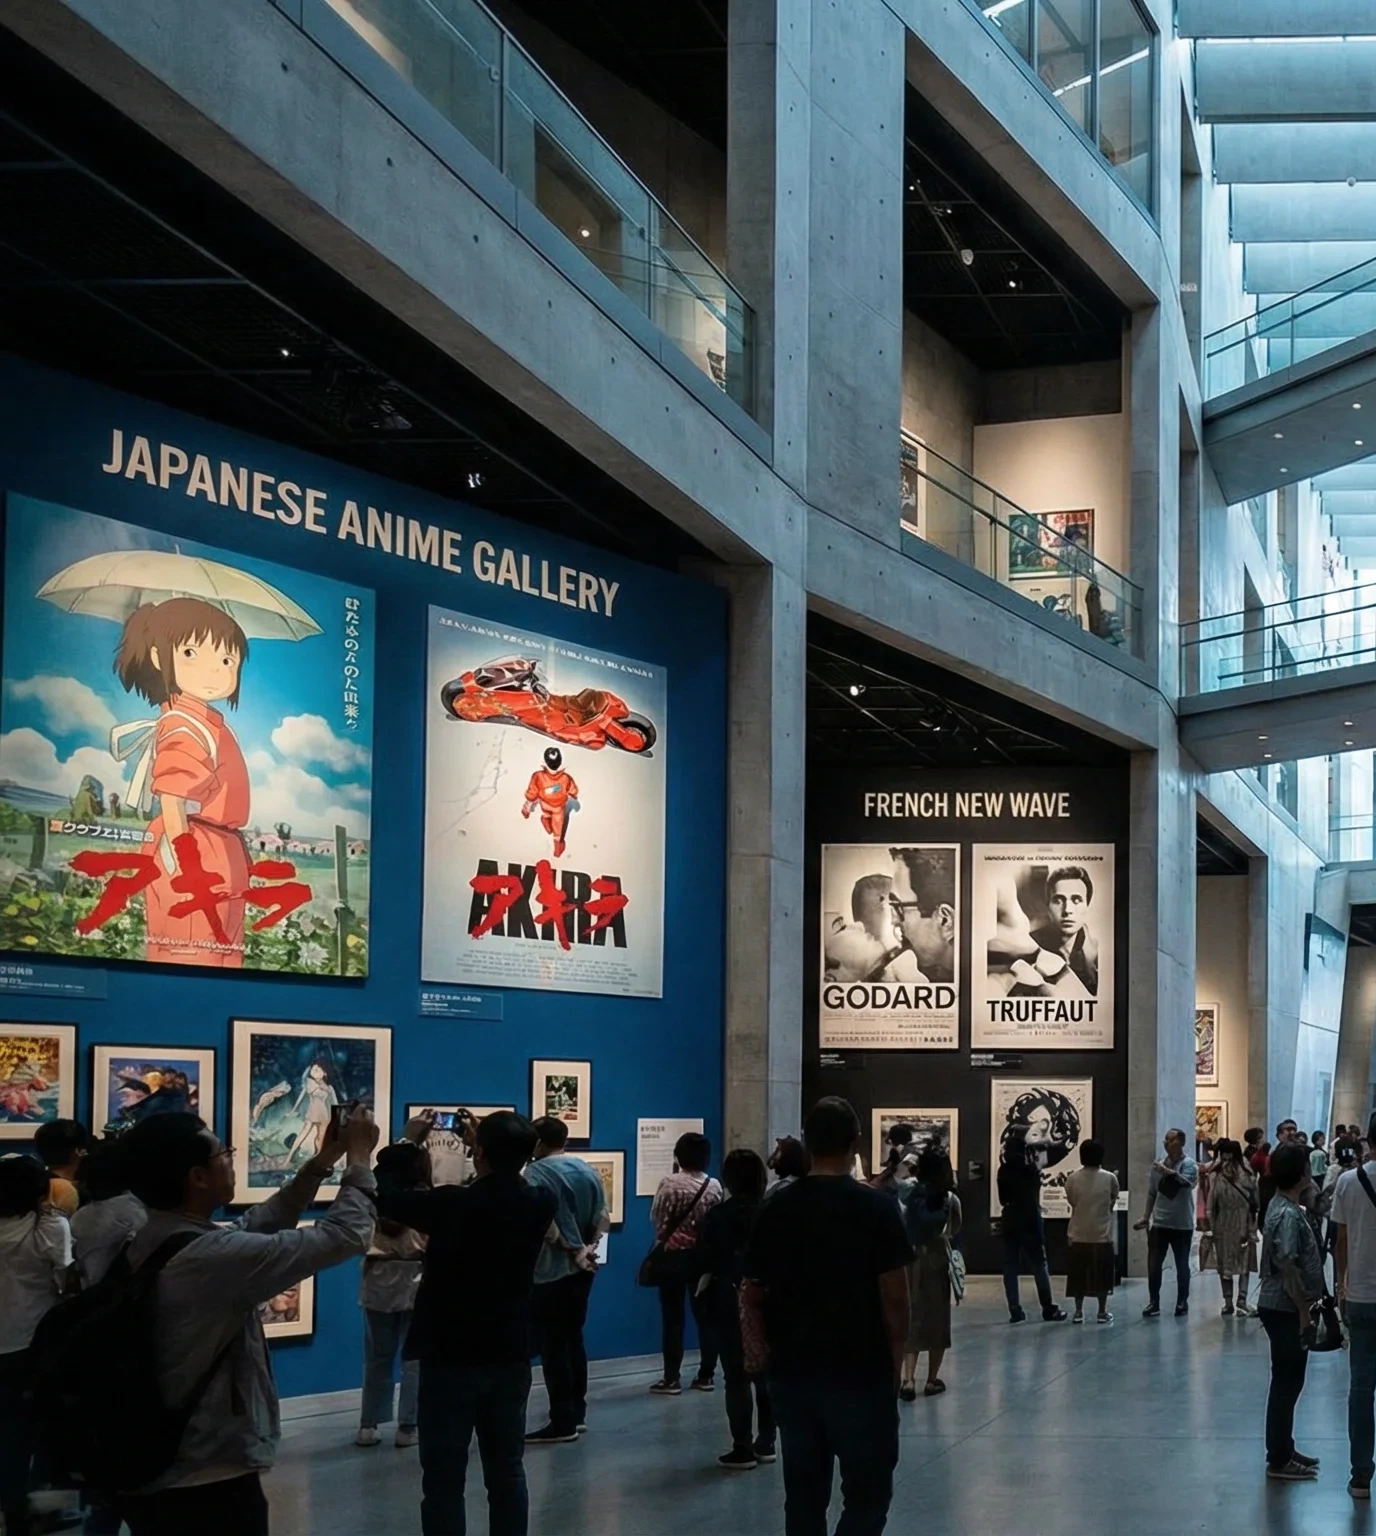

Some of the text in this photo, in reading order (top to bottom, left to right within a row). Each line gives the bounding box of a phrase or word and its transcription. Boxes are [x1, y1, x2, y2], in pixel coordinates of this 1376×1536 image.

[102, 429, 621, 618] JAPANESE ANIME GALLERY
[864, 792, 1070, 818] FRENCH NEW WAVE
[68, 832, 314, 948] アキラ
[469, 859, 630, 952] アキラ
[823, 985, 956, 1009] GODARD
[986, 1000, 1098, 1022] TRUFFAUT
